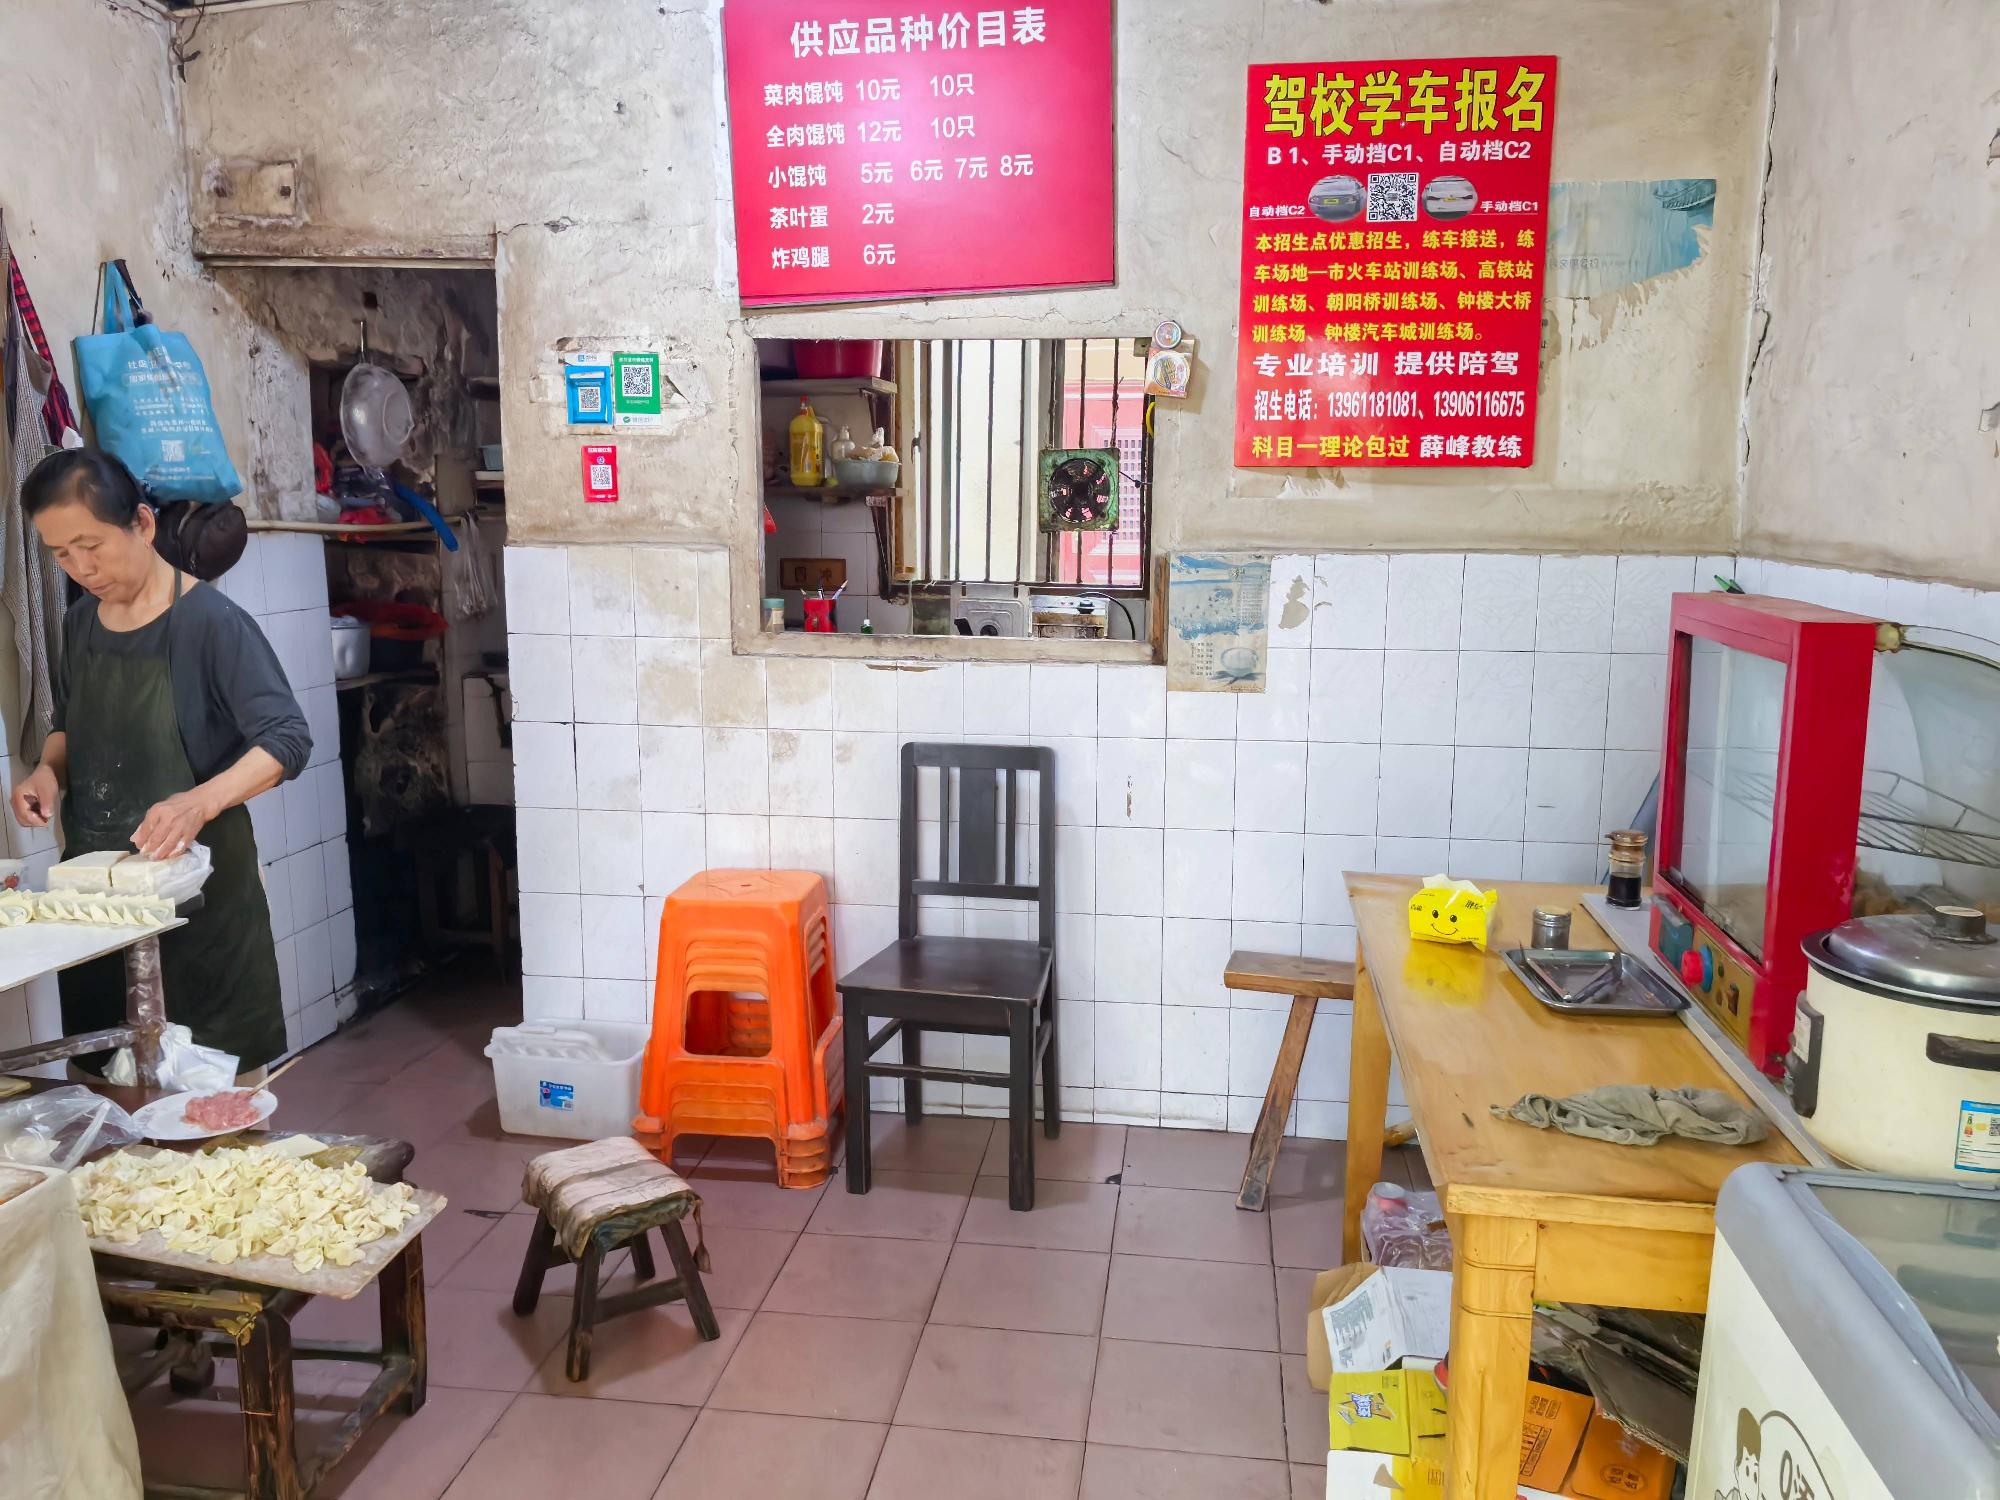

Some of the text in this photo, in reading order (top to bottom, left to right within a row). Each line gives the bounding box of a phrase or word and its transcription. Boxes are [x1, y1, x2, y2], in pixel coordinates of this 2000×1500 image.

[791, 7, 1046, 58] 供应品种价目表
[764, 74, 974, 106] 菜肉馄饨 10元 10只
[1264, 66, 1545, 137] 驾校学车报名
[766, 116, 975, 147] 全肉馄饨 12元 10只
[768, 154, 1033, 188] 小馄饨 5元 6元 7元 8元
[770, 203, 894, 229] 茶叶蛋 2元
[772, 244, 895, 269] 炸鸡腿 6元
[1253, 351, 1518, 377] 专业培训 提供陪驾
[1252, 435, 1522, 459] 科目一理论包过 薛峰教练
